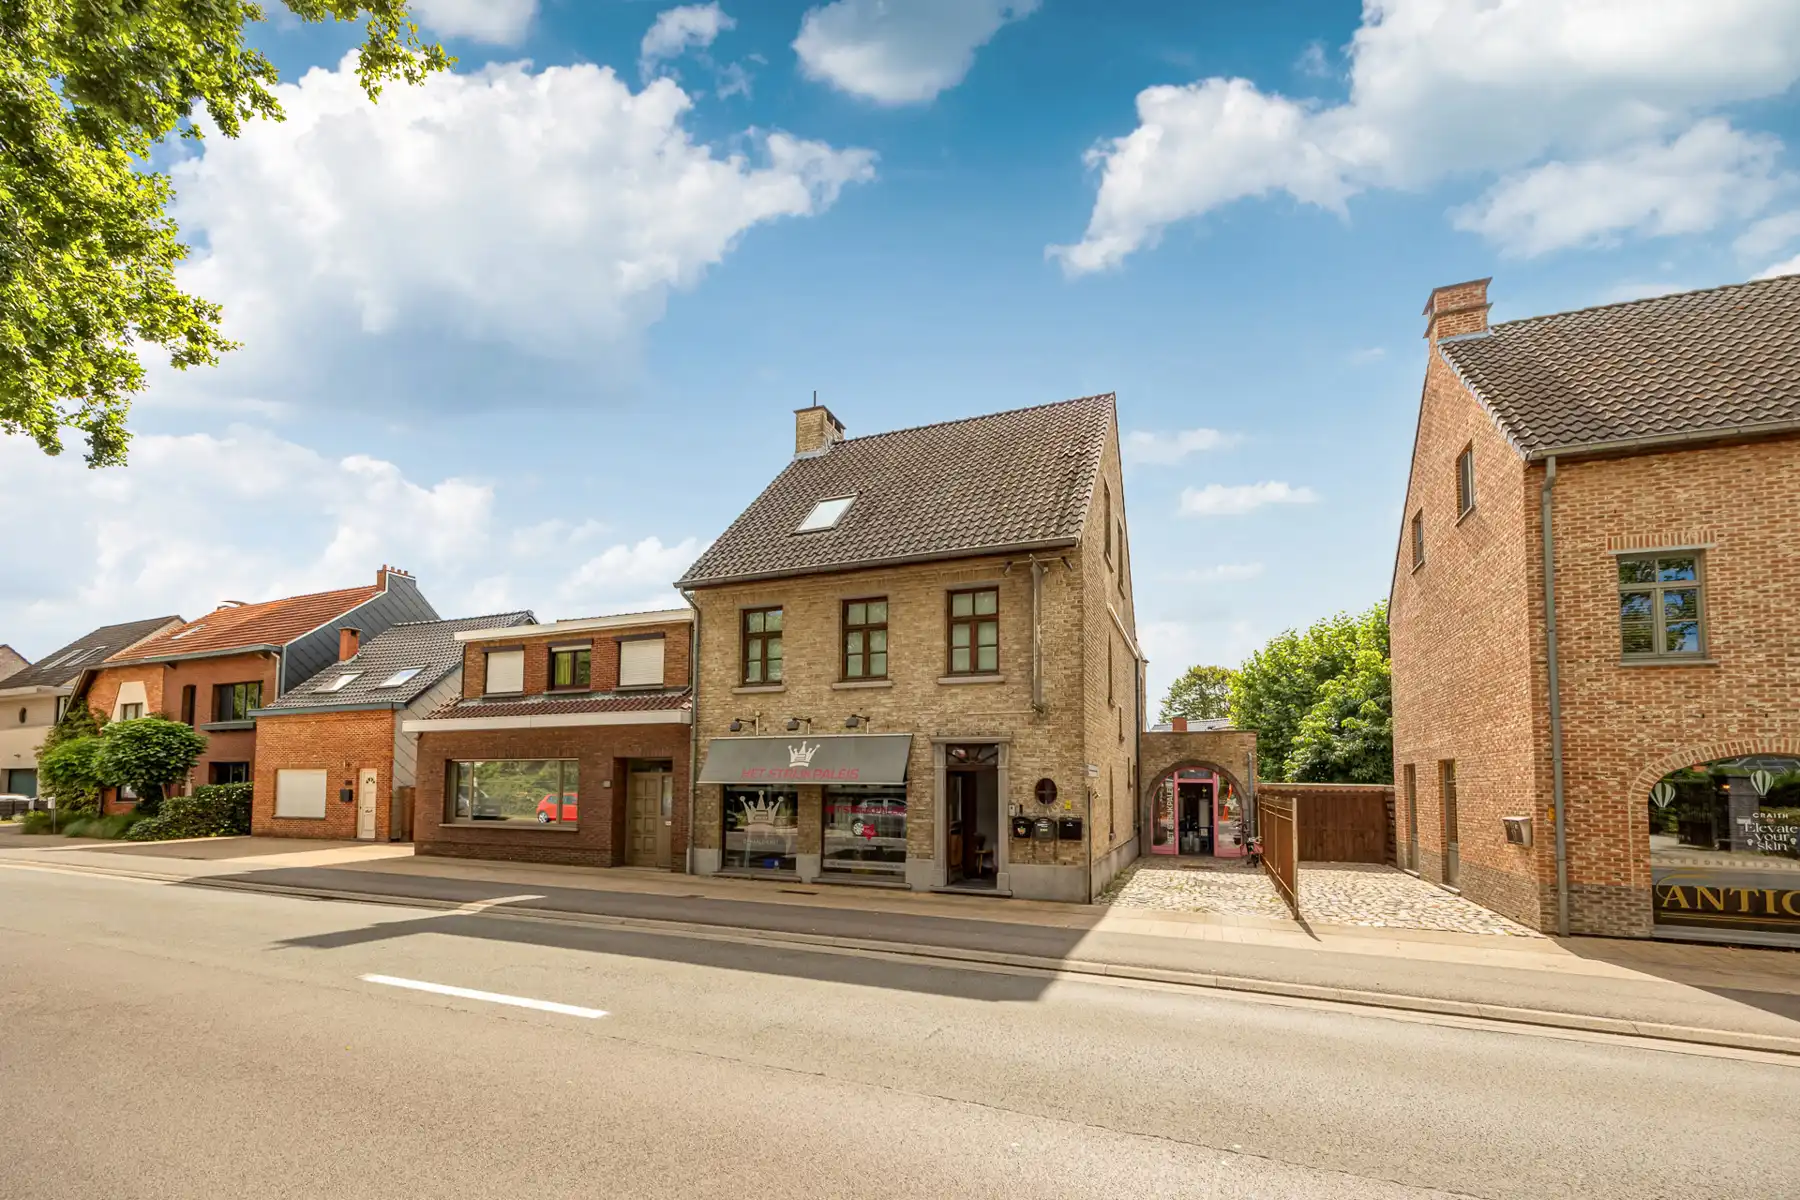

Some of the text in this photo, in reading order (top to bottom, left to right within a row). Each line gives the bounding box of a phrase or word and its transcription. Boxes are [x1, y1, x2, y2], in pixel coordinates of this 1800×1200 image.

[741, 768, 766, 780] HET
[813, 768, 859, 780] PALEIS
[1744, 822, 1798, 834] Elevate
[1755, 833, 1790, 842] your
[1757, 841, 1788, 851] skin
[1654, 857, 1800, 869] SCHOONHEIDSI
